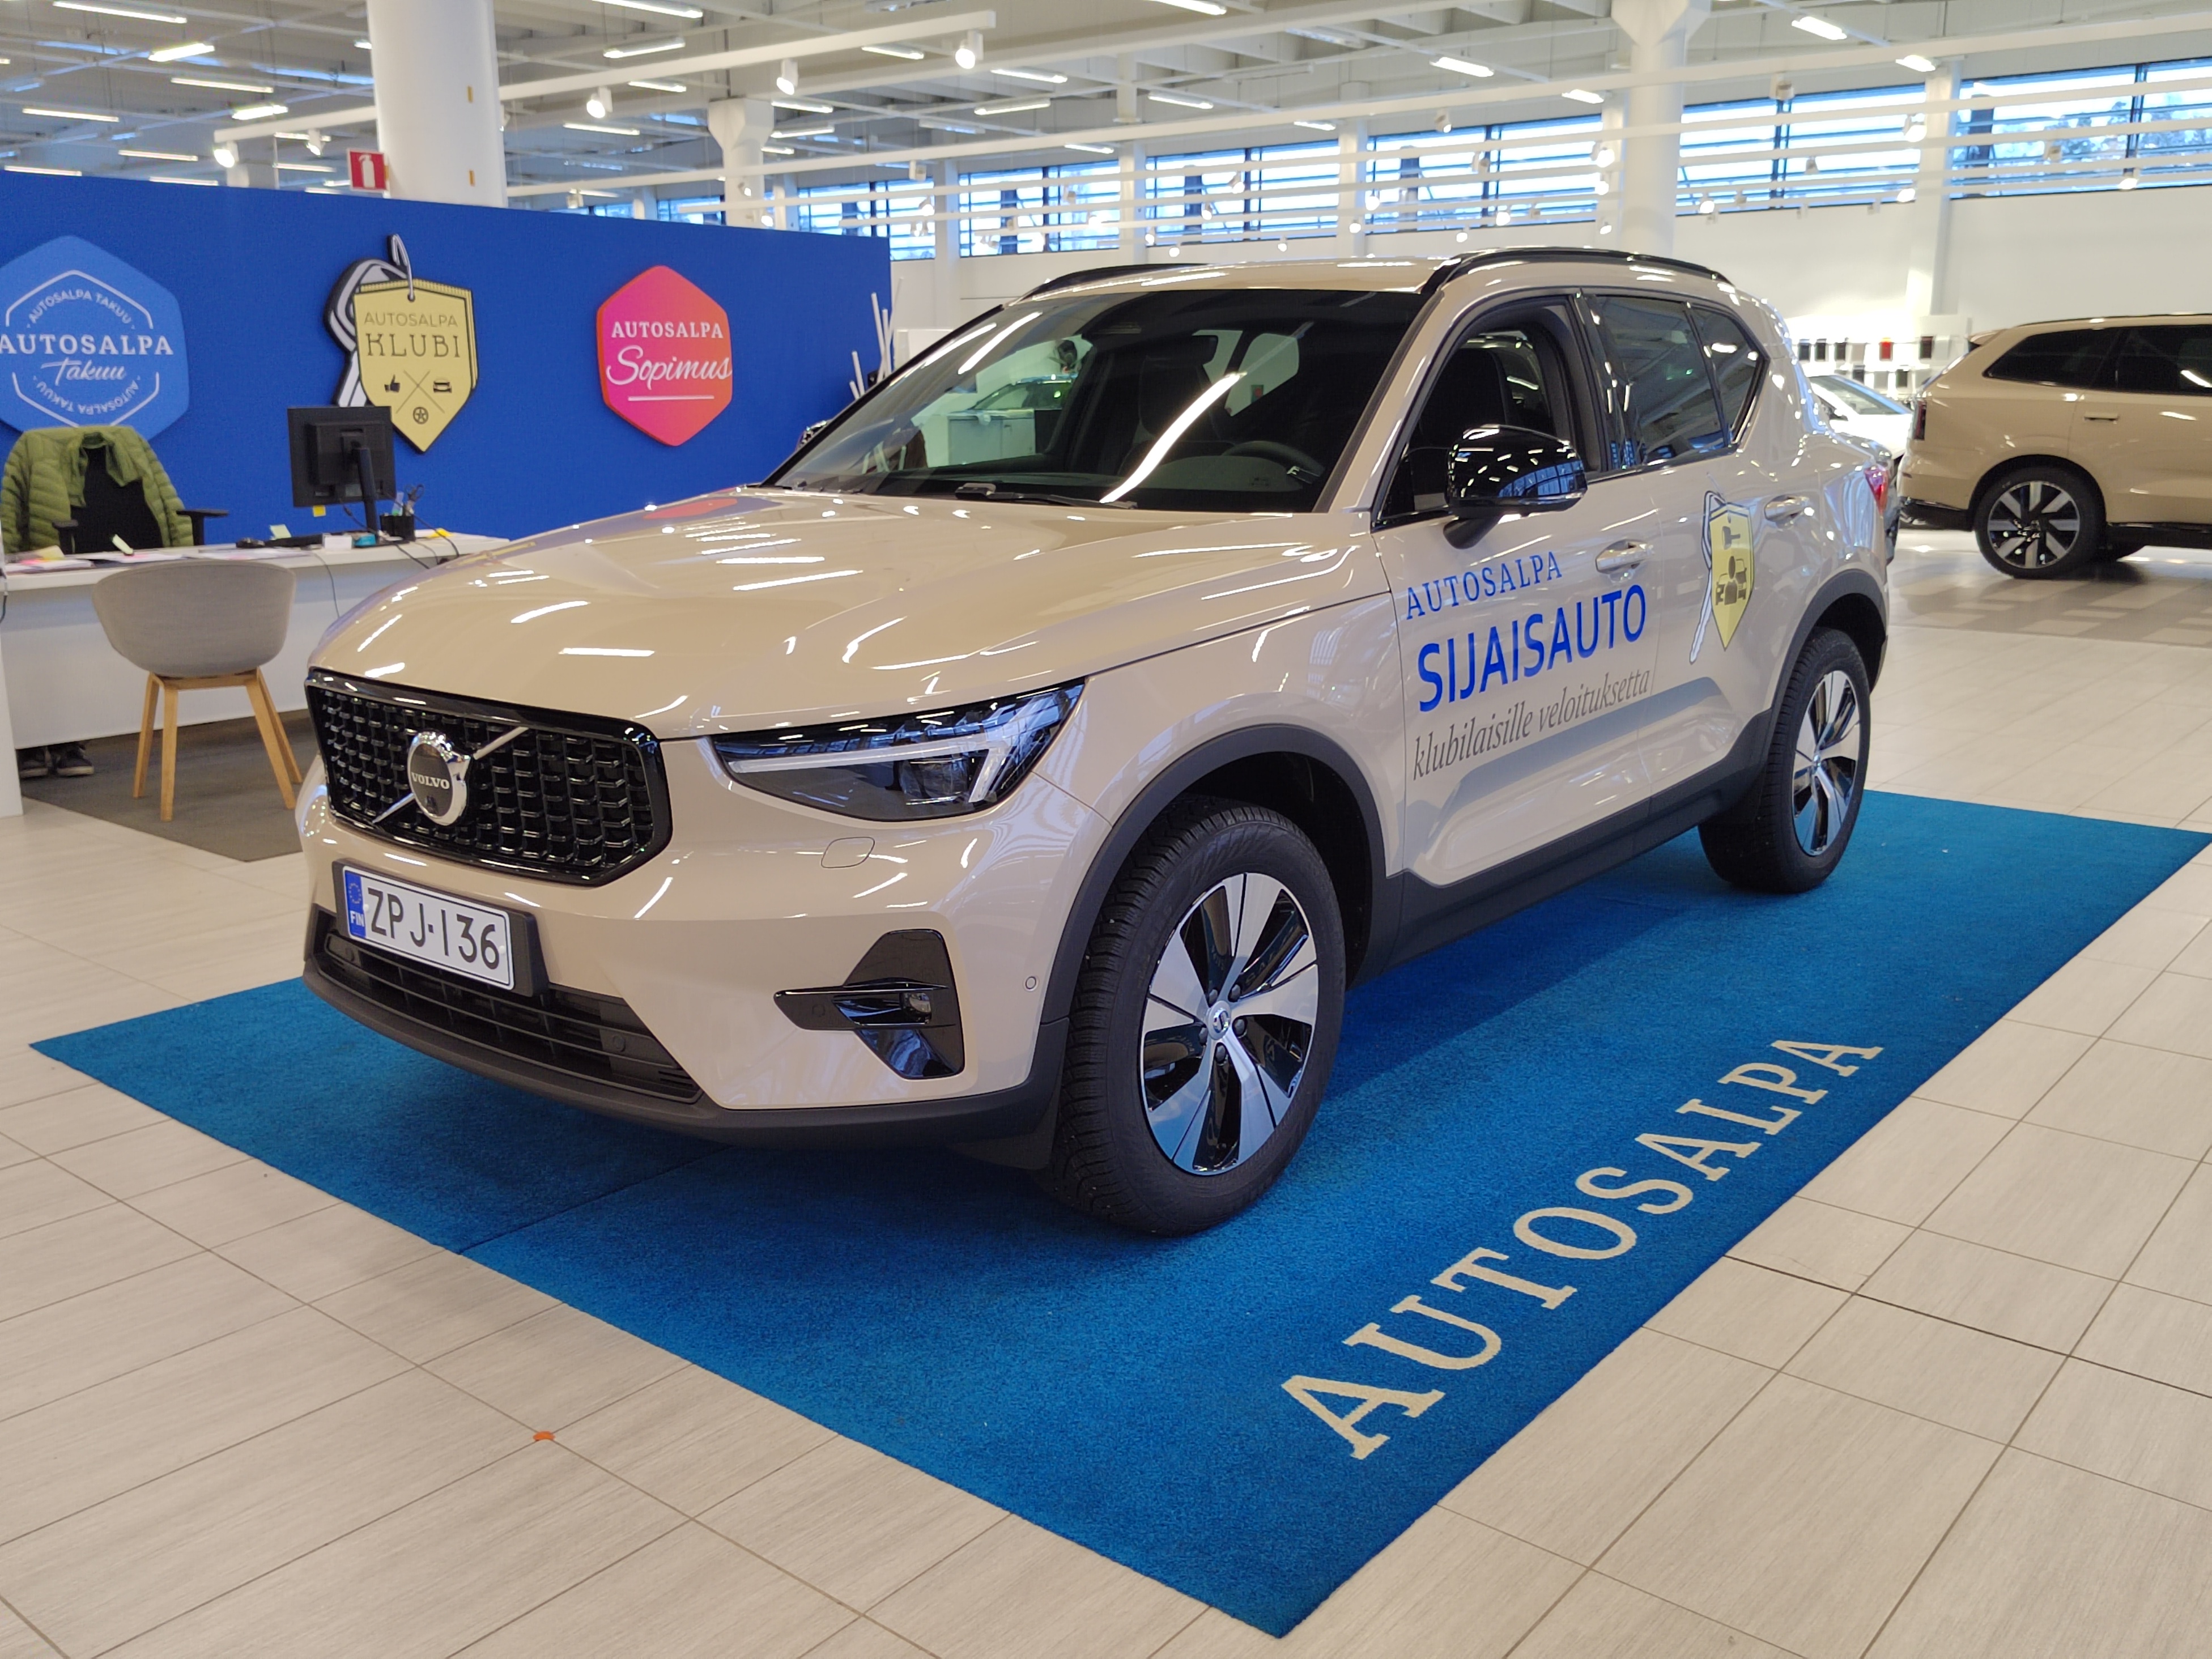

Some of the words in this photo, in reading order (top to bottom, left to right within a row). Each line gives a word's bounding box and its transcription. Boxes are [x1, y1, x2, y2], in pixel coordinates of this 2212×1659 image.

[29, 289, 92, 324] AUTOSALPA
[96, 292, 131, 324] TAKUU
[365, 312, 458, 327] AUTOSALPA
[0, 334, 173, 355] AUTOSALPA
[365, 333, 460, 358] KLUBI
[611, 322, 724, 338] AUTOSALPA
[40, 357, 126, 386] Takuu
[606, 345, 733, 389] Sopimus
[1406, 551, 1562, 620] AUTOSALPA
[1417, 585, 1645, 712] SIJAISAUTO
[1413, 702, 1533, 780] klubilaisille
[1538, 669, 1651, 733] veloituksetta
[411, 772, 450, 789] VOLVO
[351, 911, 365, 928] FIN
[367, 887, 500, 970] ZPJ-136
[1281, 1040, 1884, 1460] AUTOSALPA
